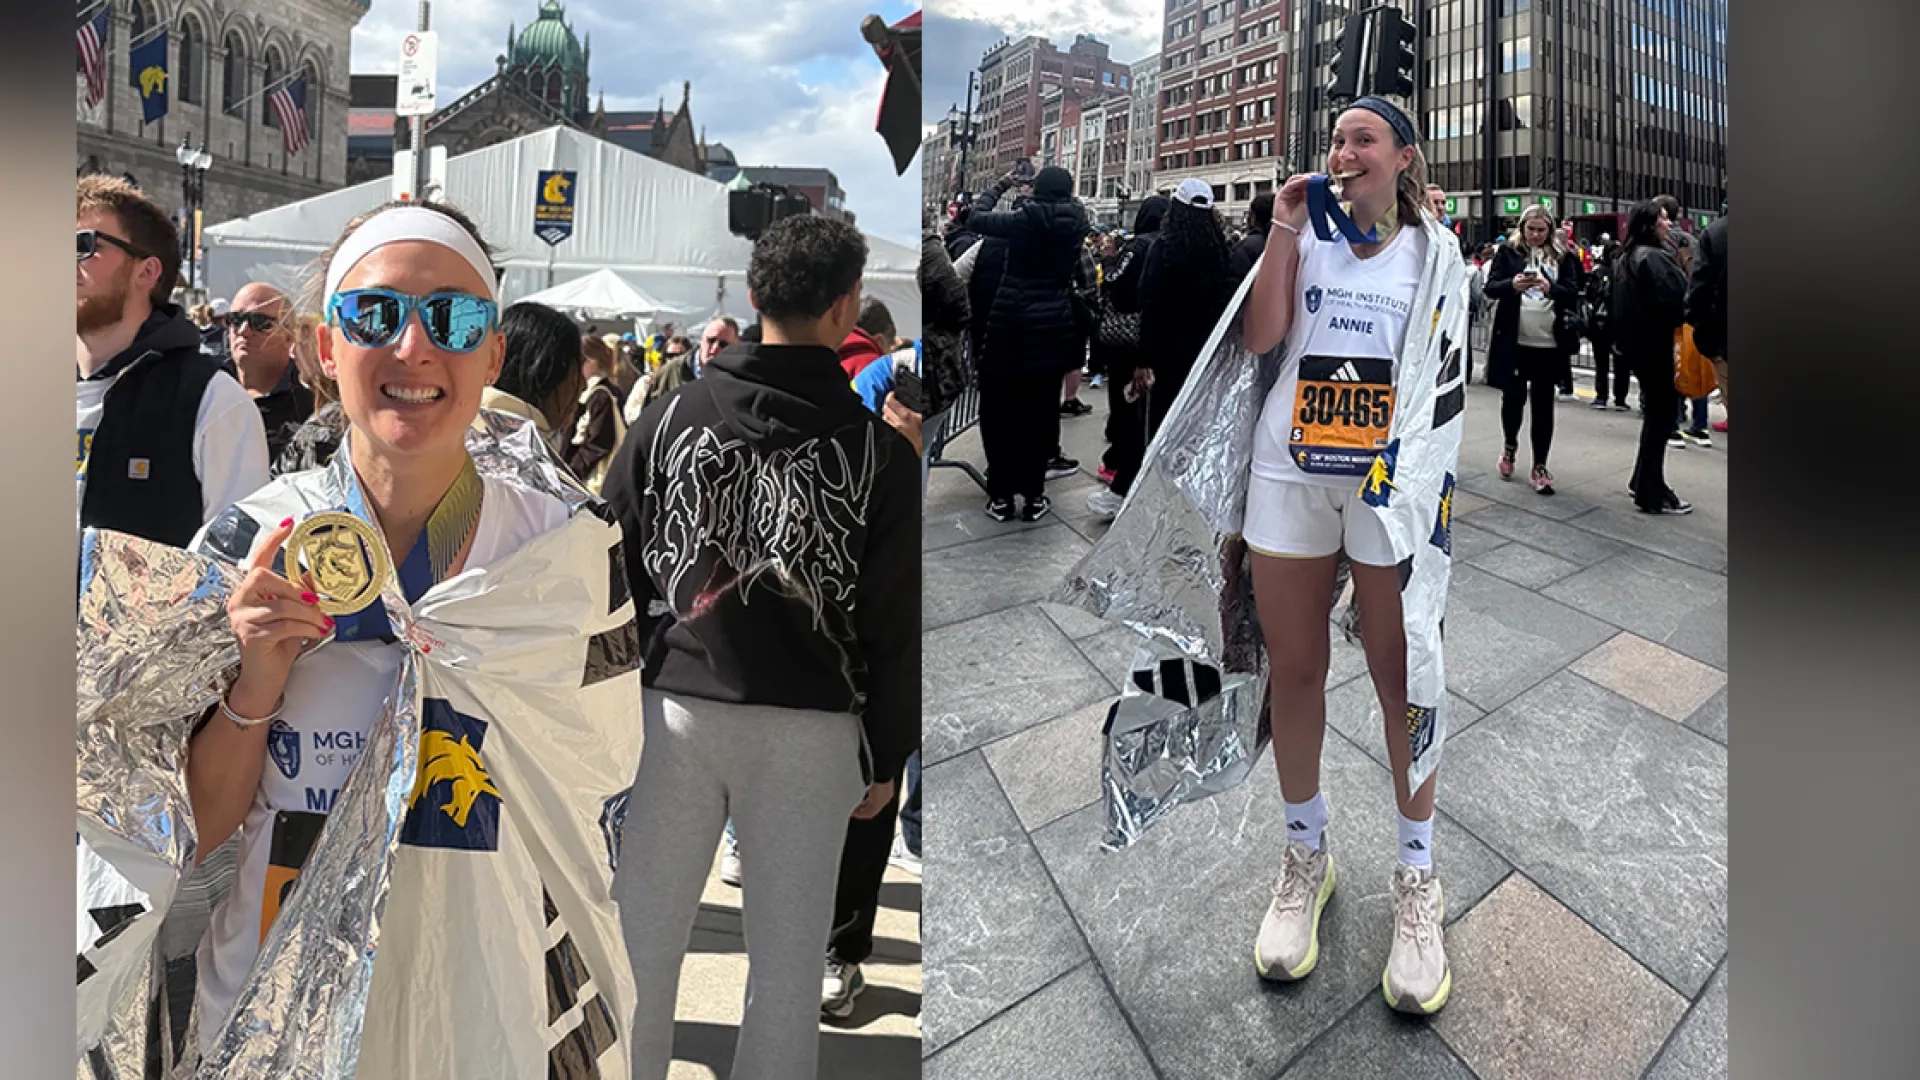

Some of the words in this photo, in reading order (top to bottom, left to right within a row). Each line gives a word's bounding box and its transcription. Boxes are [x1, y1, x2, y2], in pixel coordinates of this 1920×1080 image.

[1505, 198, 1519, 210] TD
[1327, 288, 1353, 299] MGH
[1355, 292, 1409, 313] INSTITUTE
[1328, 316, 1374, 334] ANNIE
[1299, 385, 1391, 428] 30465
[1293, 428, 1302, 440] S
[315, 753, 336, 766] OF
